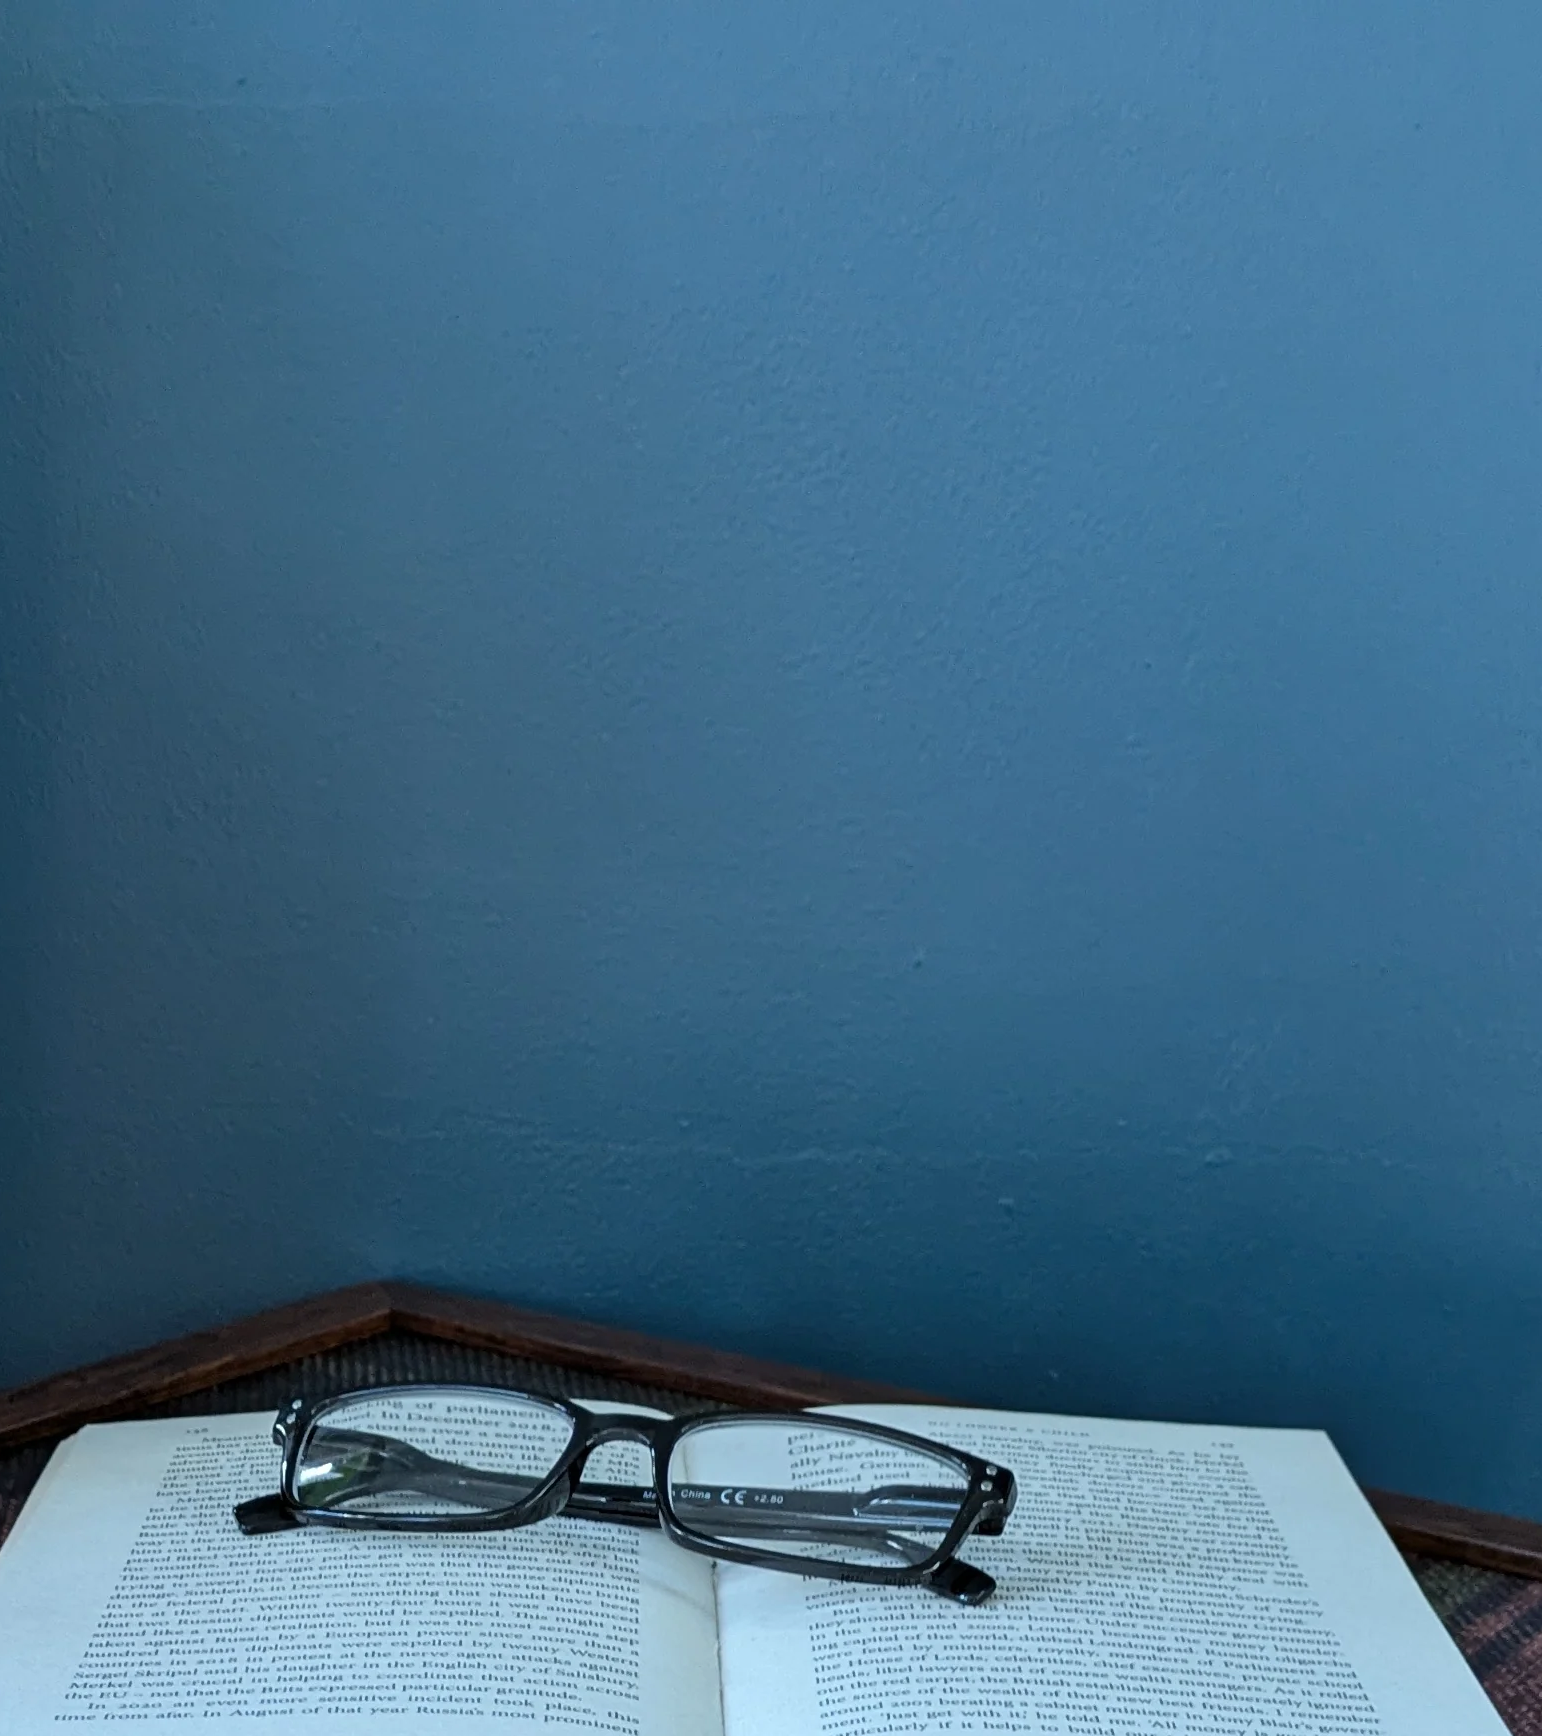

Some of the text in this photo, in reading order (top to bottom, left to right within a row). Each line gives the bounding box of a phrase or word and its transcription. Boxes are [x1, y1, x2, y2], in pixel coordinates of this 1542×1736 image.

[407, 1413, 500, 1426] December
[446, 1405, 546, 1420] parliament
[367, 1424, 426, 1432] stories
[495, 1433, 545, 1441] series
[445, 1438, 545, 1452] documents
[464, 1449, 513, 1459] didn't
[828, 1448, 897, 1462] Navalny
[680, 1489, 711, 1499] China
[73, 1671, 129, 1681] Sergei
[134, 1668, 199, 1679] Skripal
[276, 1662, 357, 1673] daughter
[422, 1661, 488, 1671] English
[493, 1663, 527, 1674] city
[271, 1653, 333, 1664] protest
[511, 1654, 572, 1667] attacks
[579, 1662, 639, 1679] against
[69, 1680, 133, 1690] Merkel
[181, 1676, 244, 1687] crucial
[276, 1674, 344, 1684] helping
[376, 1672, 474, 1681] coordinate
[481, 1673, 515, 1684] that
[523, 1678, 578, 1690] action
[585, 1685, 640, 1701] across
[308, 1683, 397, 1694] expressed
[402, 1684, 492, 1693] particular
[876, 1665, 913, 1676] libel
[919, 1665, 985, 1674] lawyers
[1052, 1670, 1110, 1680] course
[1115, 1674, 1173, 1685] wealth
[1319, 1691, 1370, 1702] rolled
[1013, 1676, 1072, 1688] British
[1075, 1682, 1198, 1698] establishment
[1201, 1691, 1303, 1709] deliberately
[1307, 1700, 1376, 1713] ignored
[408, 1694, 483, 1704] incident
[494, 1698, 535, 1709] took
[607, 1711, 640, 1725] this
[820, 1701, 884, 1720] around
[939, 1698, 1015, 1709] berating
[1034, 1701, 1100, 1712] cabinet
[1105, 1706, 1180, 1719] minister
[1259, 1718, 1313, 1731] Blair's
[853, 1689, 911, 1702] source
[978, 1687, 1036, 1697] wealth
[1067, 1691, 1109, 1702] their
[1159, 1698, 1195, 1709] best
[1290, 1711, 1381, 1725] remember
[229, 1708, 295, 1718] August
[417, 1706, 485, 1716] Russia's
[492, 1710, 536, 1720] most
[544, 1715, 640, 1736] prominent
[961, 1709, 1002, 1718] with
[1065, 1714, 1101, 1724] told
[983, 1721, 1032, 1733] helps
[1068, 1725, 1116, 1736] build
